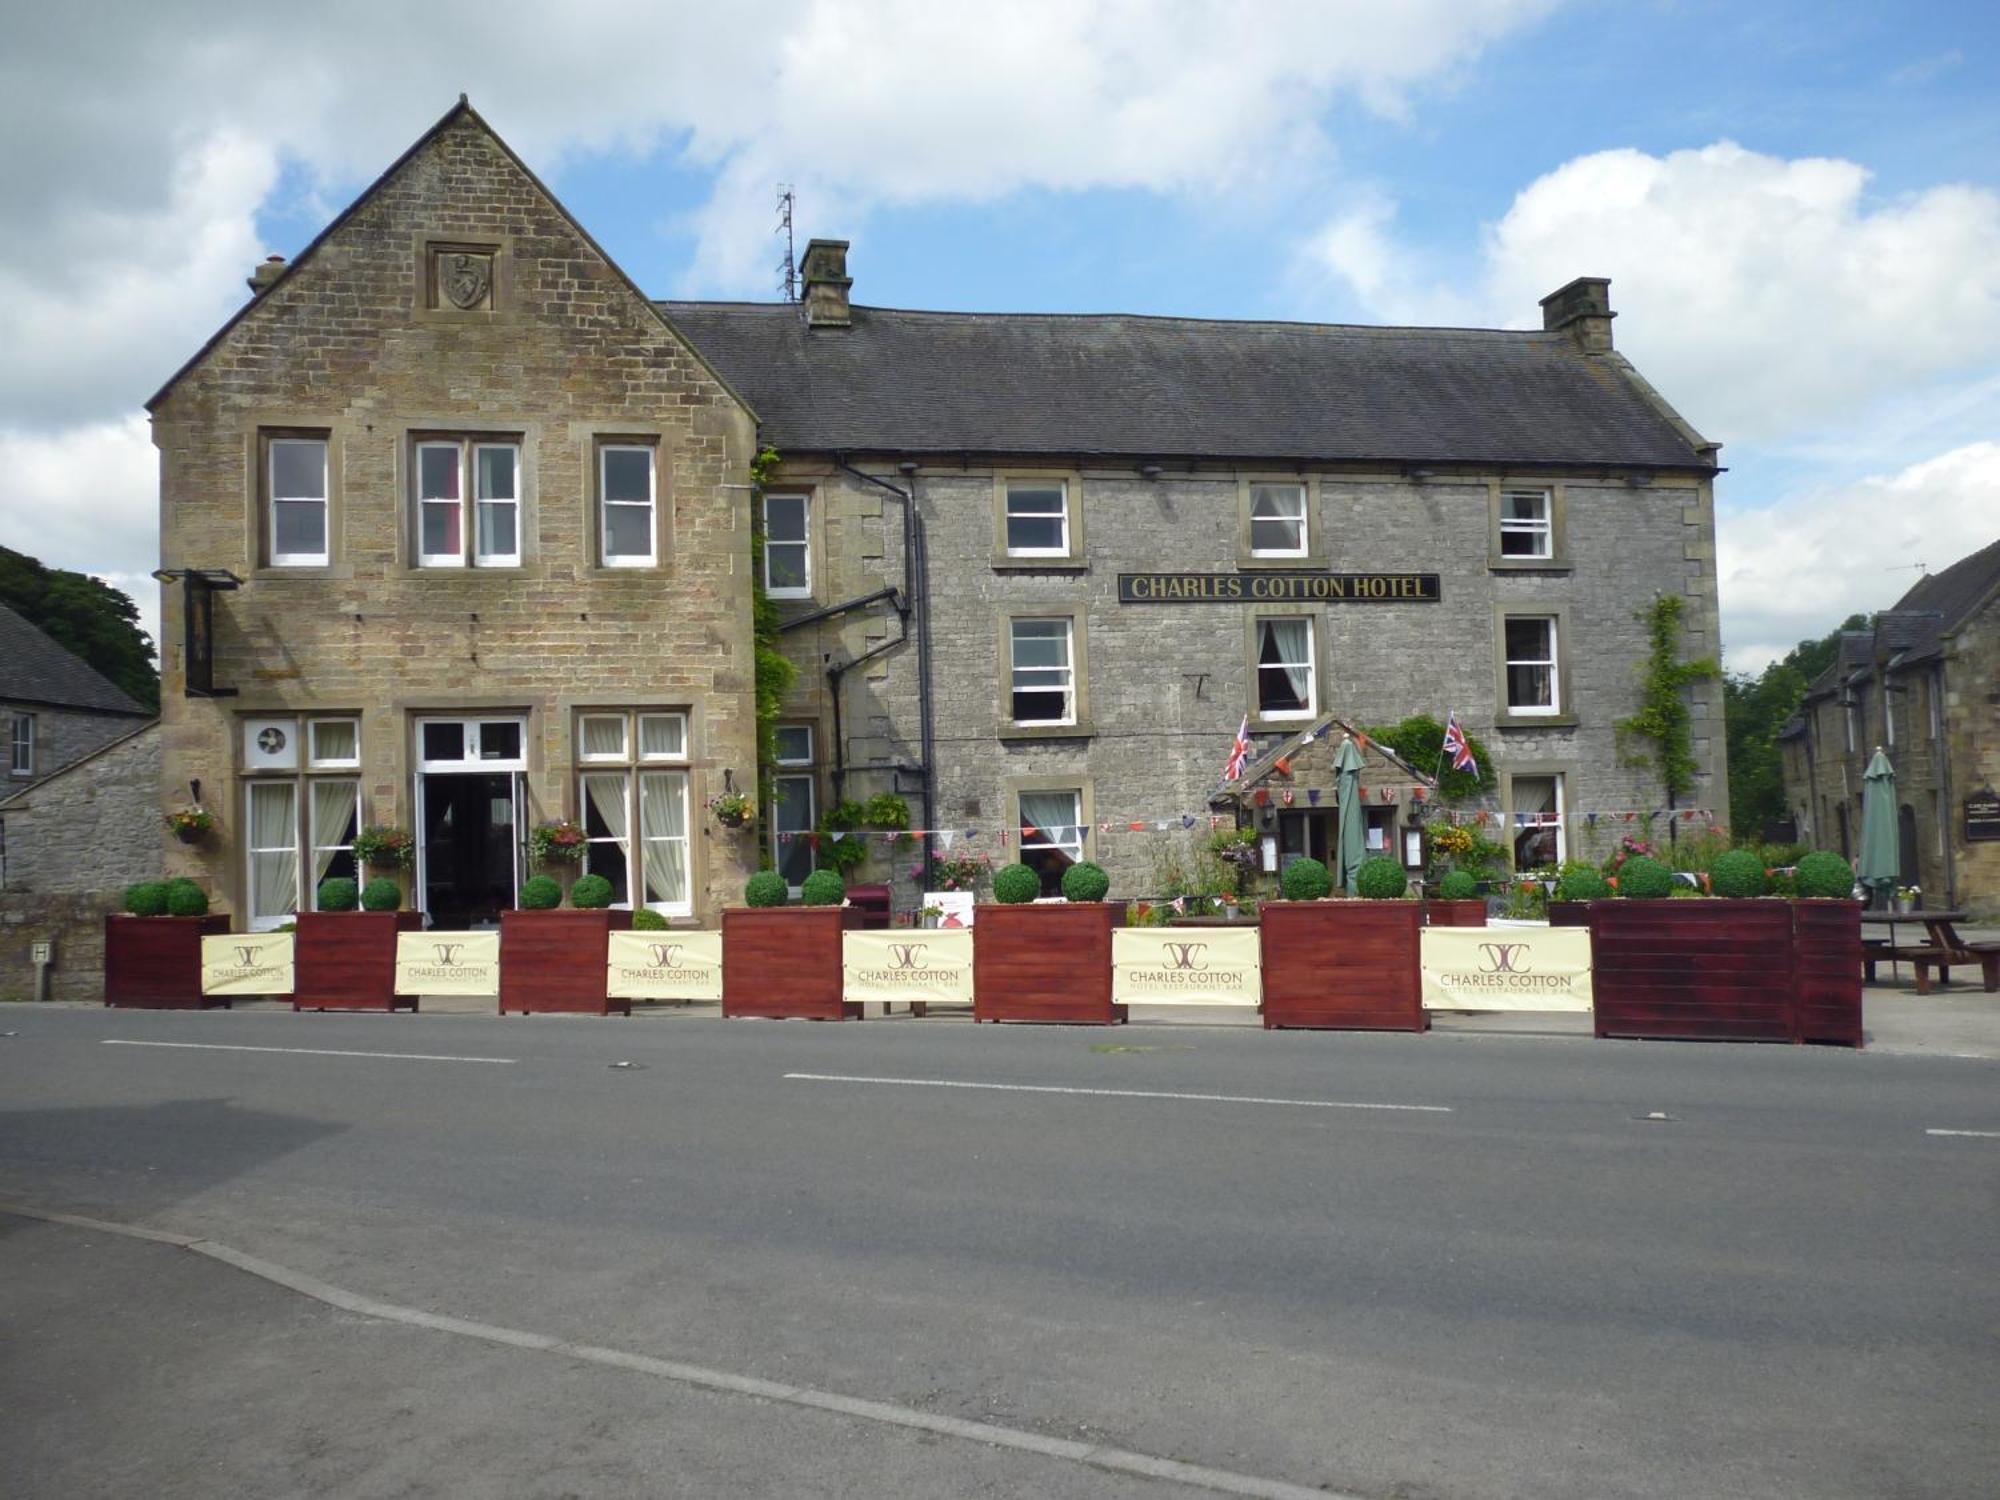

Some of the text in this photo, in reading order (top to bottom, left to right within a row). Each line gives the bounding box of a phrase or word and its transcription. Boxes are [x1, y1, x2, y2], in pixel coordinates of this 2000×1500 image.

[1131, 577, 1427, 598] CHARLES COTTON HOTEL
[408, 967, 487, 977] CHARLES COTTON
[622, 968, 709, 979] CHARLES COTTON
[858, 970, 958, 981] CHARLES COTTON
[1130, 971, 1242, 983] CHARLES COTTON
[1441, 974, 1572, 987] CHARLES COTTON
